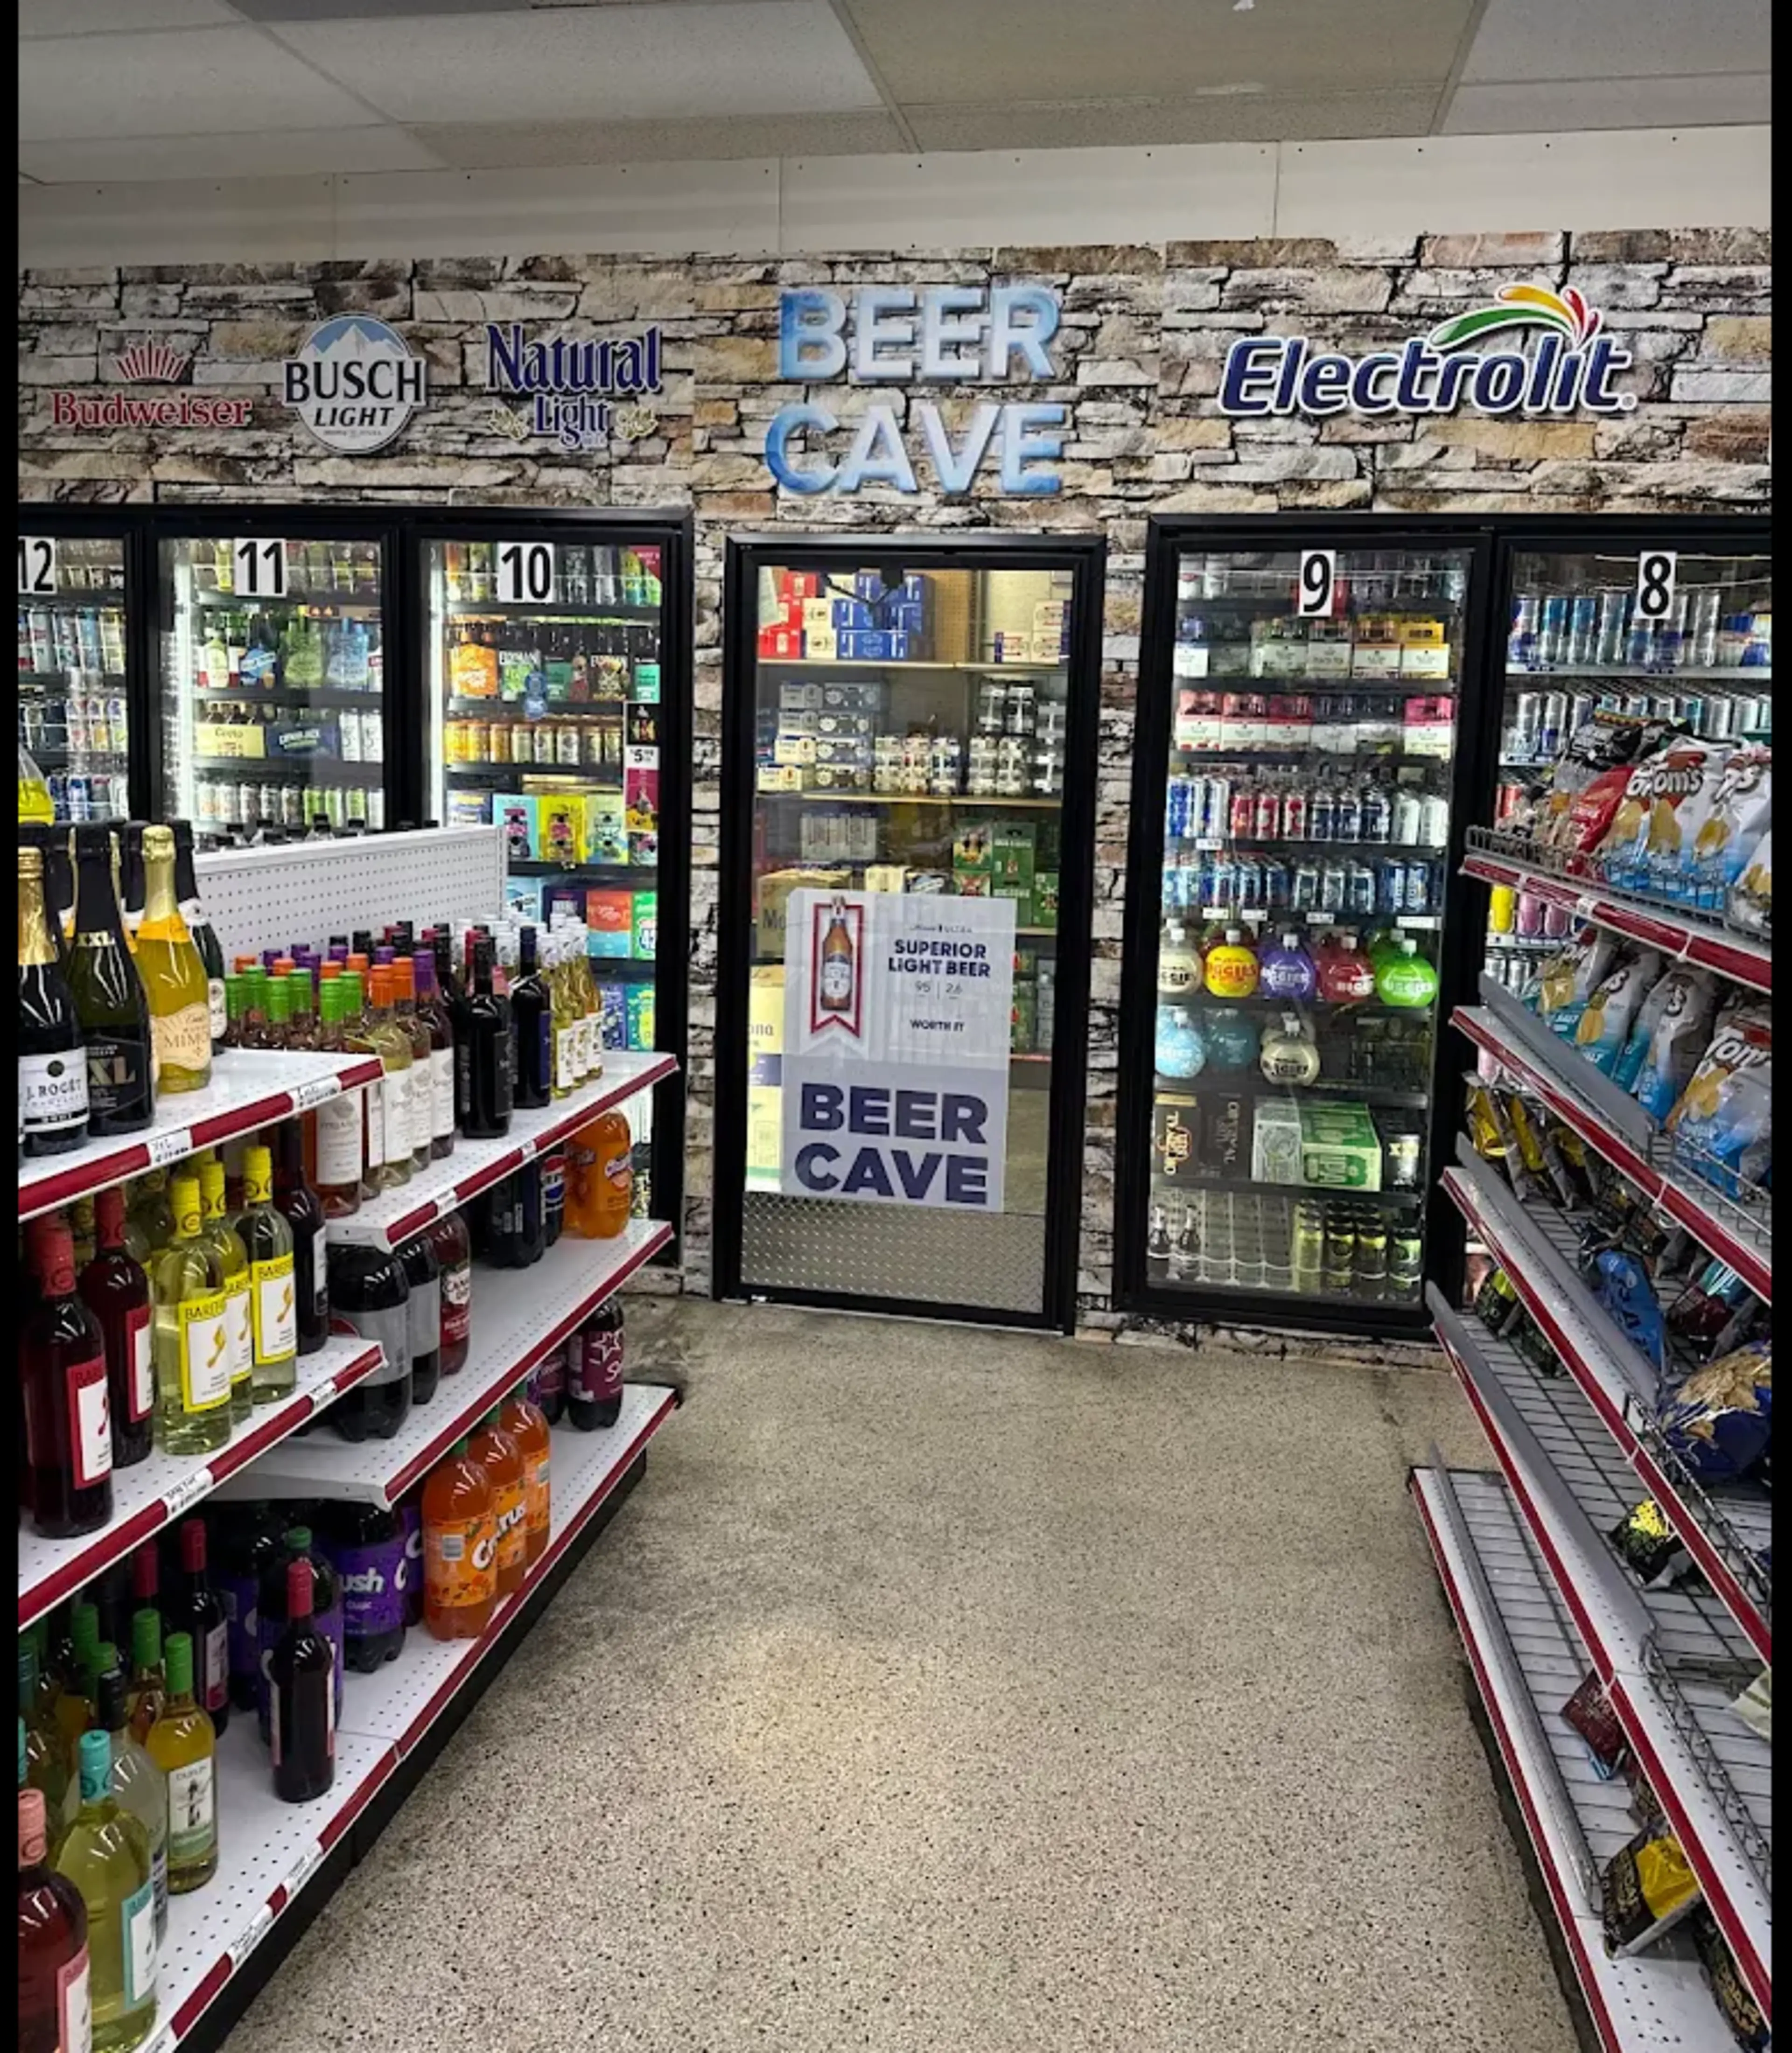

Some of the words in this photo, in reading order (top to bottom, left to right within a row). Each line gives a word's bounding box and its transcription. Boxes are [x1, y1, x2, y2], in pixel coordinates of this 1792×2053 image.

[486, 324, 662, 392] Natural
[780, 286, 1059, 379] BEER
[285, 361, 421, 403] BUSCH
[1222, 334, 1629, 412] Electrolit
[51, 391, 252, 426] Budweiser
[314, 407, 394, 426] LIGHT
[534, 395, 609, 449] Light
[765, 403, 1065, 495] CAVE
[238, 541, 283, 594] 11
[501, 545, 551, 601] 10
[1302, 553, 1331, 613] 9
[1640, 554, 1672, 616] 8
[888, 957, 942, 975] LIGHT
[945, 960, 991, 978] BEER
[895, 939, 986, 959] SUPERIOR
[910, 1020, 951, 1031] WORTH
[800, 1083, 988, 1144] BEER
[795, 1142, 988, 1205] CAVE
[337, 1567, 385, 1593] ush
